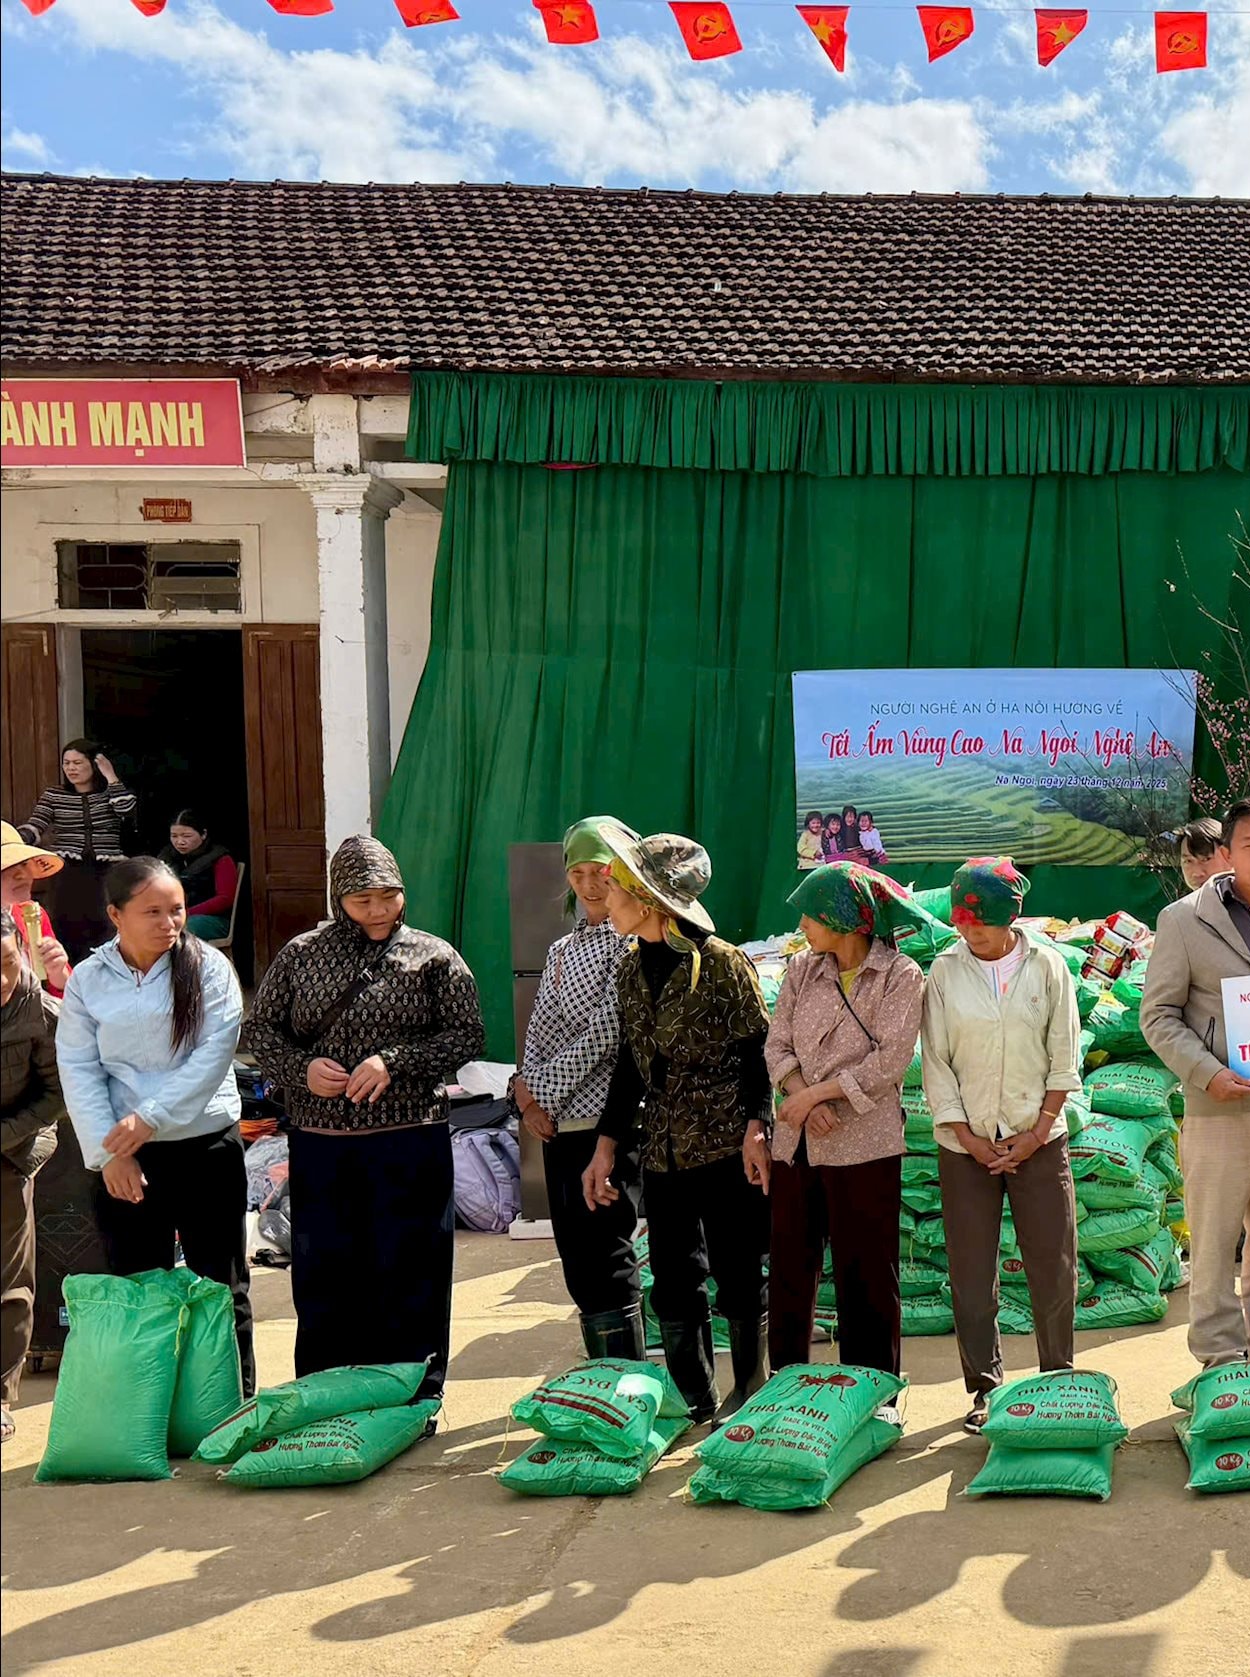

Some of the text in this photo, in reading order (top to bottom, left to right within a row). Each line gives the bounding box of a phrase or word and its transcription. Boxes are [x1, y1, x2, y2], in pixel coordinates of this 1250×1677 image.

[88, 401, 205, 457] MẠNH
[963, 703, 981, 714] AN
[852, 719, 894, 759] Ấm
[950, 728, 987, 757] Cao
[989, 725, 1026, 758] Na
[995, 775, 1009, 786] Na
